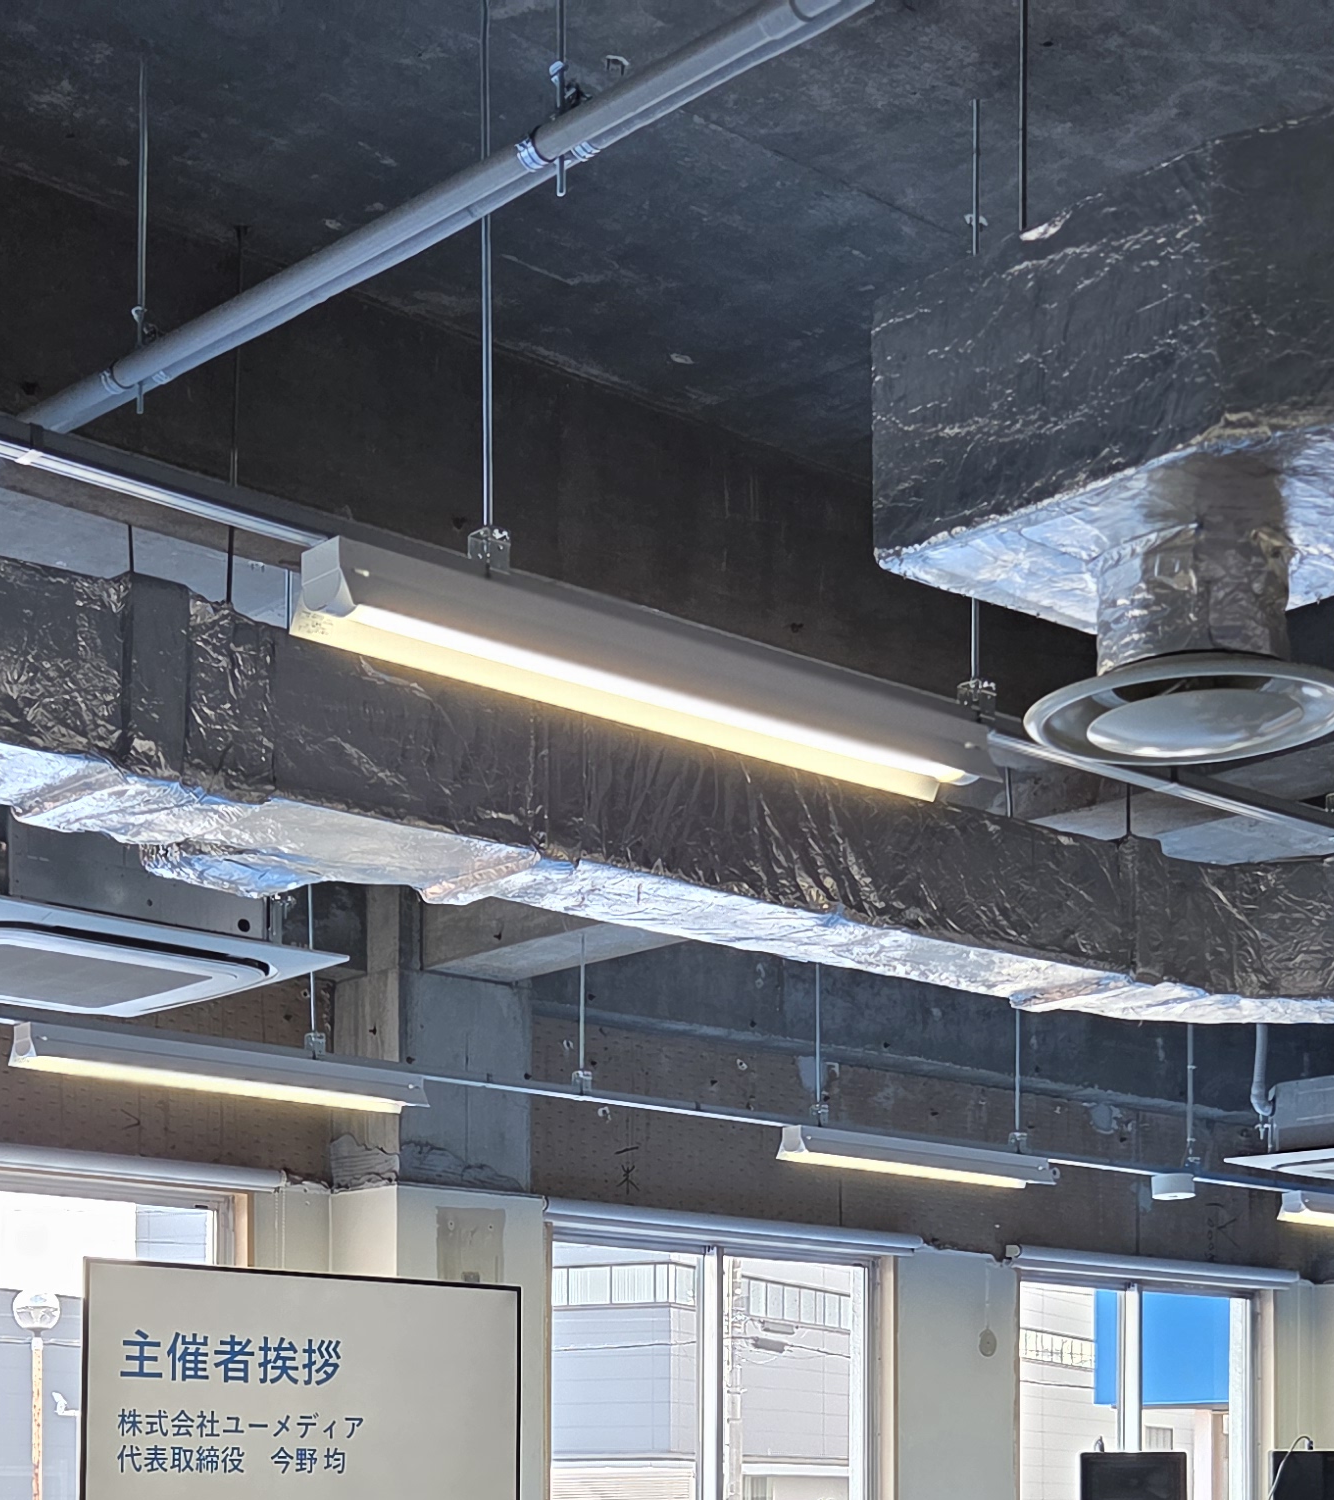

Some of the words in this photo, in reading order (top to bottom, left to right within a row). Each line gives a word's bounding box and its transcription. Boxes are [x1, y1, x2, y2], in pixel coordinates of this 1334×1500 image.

[120, 1329, 342, 1386] 主催者挨拶
[117, 1408, 365, 1439] 株式会社ユーメディア
[116, 1444, 245, 1474] 代表取締役
